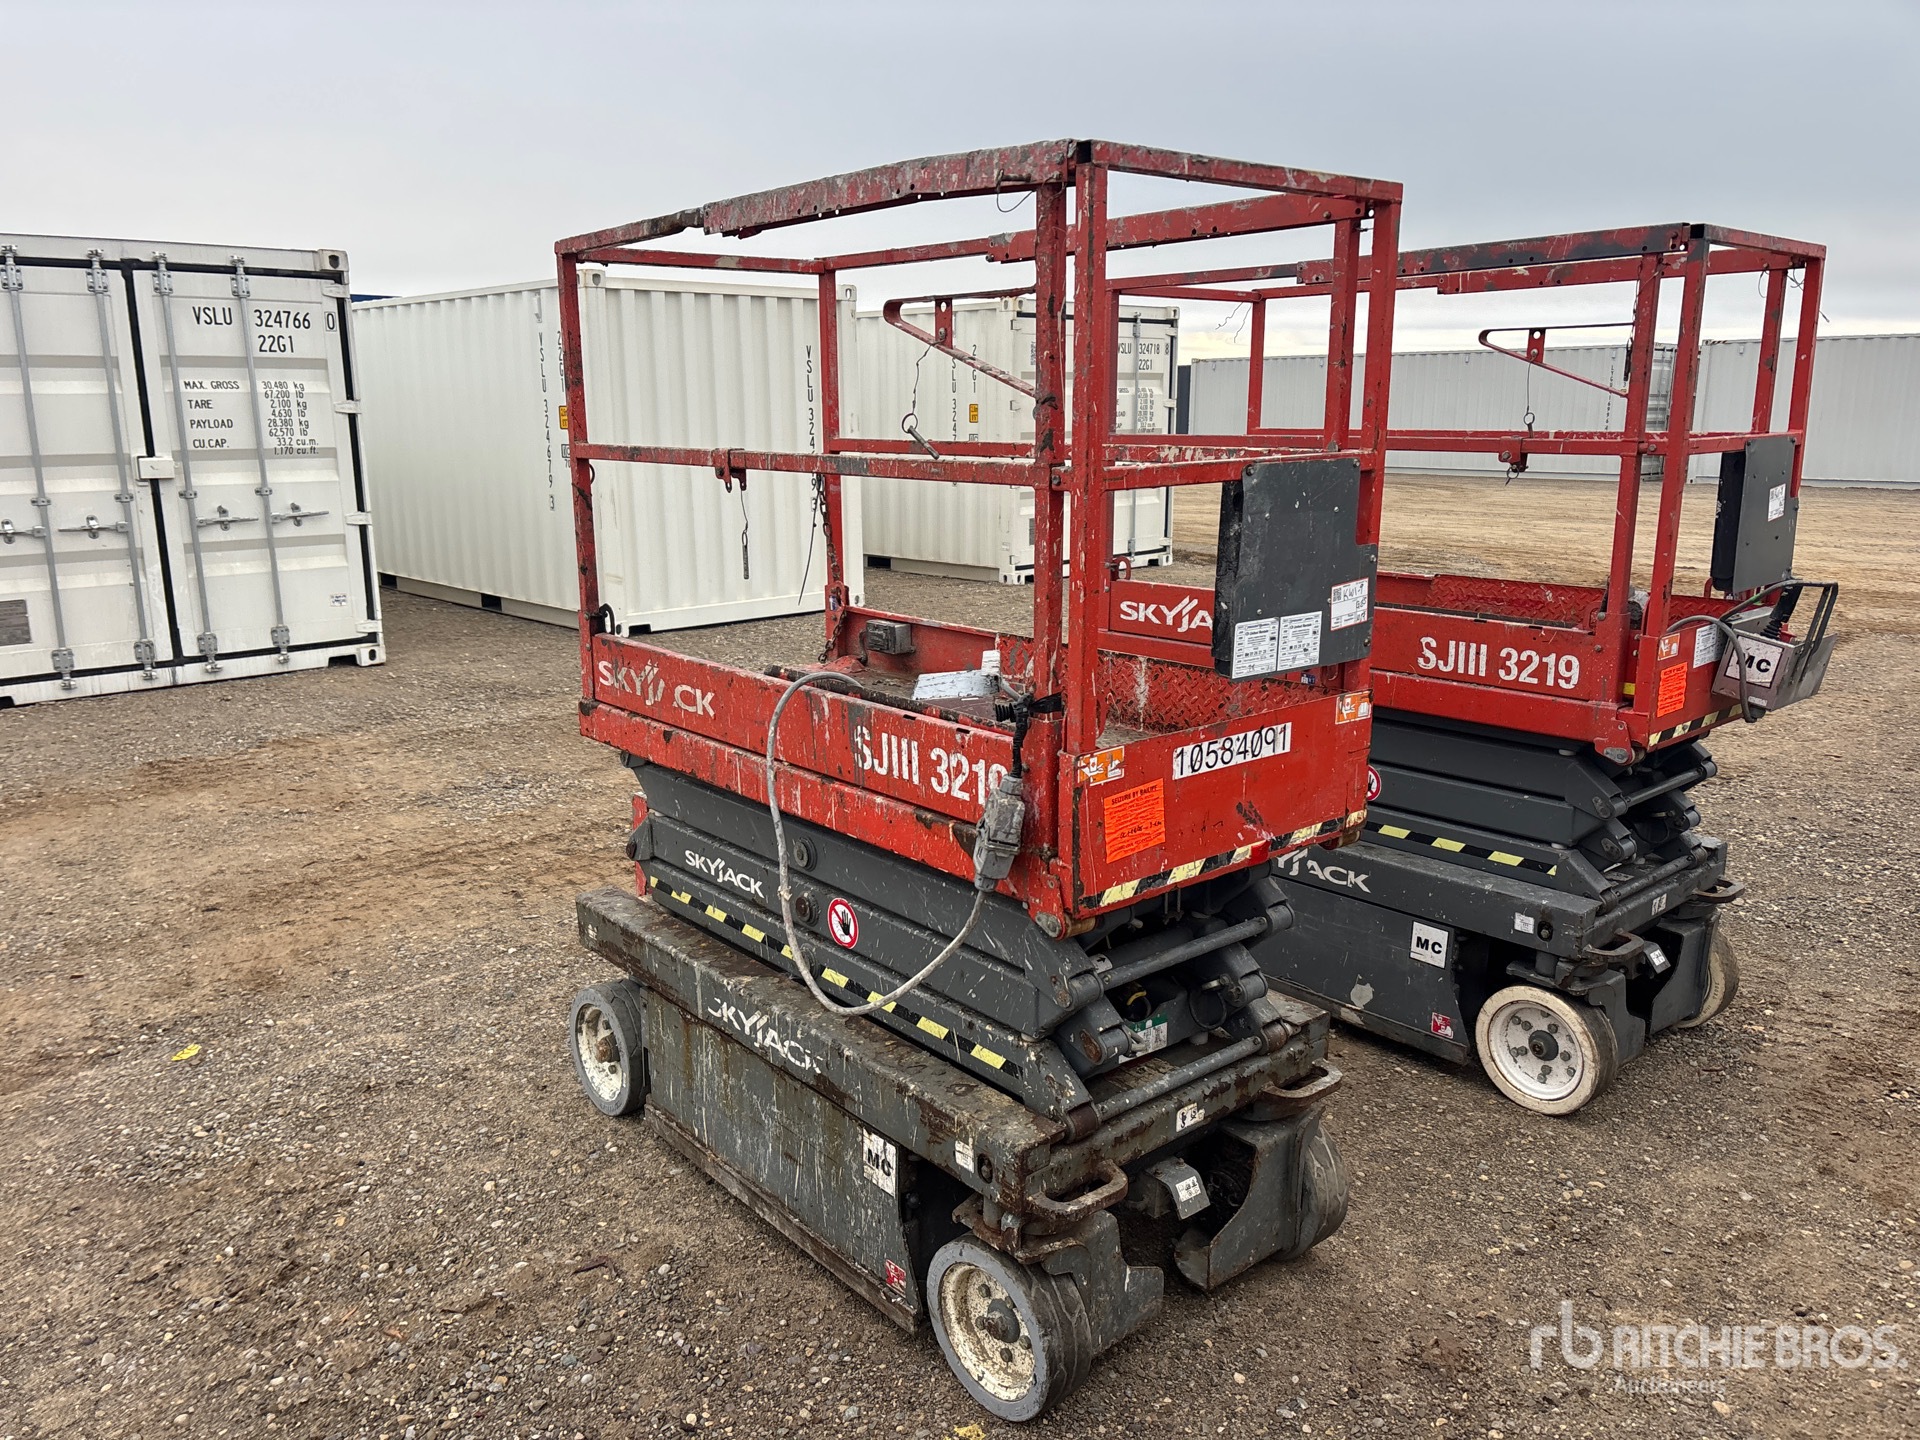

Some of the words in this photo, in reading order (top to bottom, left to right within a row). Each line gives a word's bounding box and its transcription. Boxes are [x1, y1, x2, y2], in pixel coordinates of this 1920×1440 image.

[192, 306, 233, 325] VSLU
[253, 309, 311, 329] 324766
[326, 312, 335, 331] 0
[257, 334, 294, 353] 22G1
[1138, 343, 1160, 355] 324718
[1138, 359, 1152, 370] 22G1
[184, 381, 207, 389] MAX.
[211, 381, 240, 389] GROSS
[261, 381, 288, 389] 30.480
[293, 382, 305, 391] kg
[264, 390, 290, 399] 67.200
[295, 390, 304, 398] lb
[187, 399, 213, 409] TARE
[270, 400, 291, 408] 2.100
[296, 400, 307, 410] kg
[271, 409, 292, 417] 4.630
[297, 409, 306, 417] lb
[539, 331, 547, 393] VSLU
[543, 398, 553, 488] 324679
[190, 419, 233, 429] PAYLOAD
[267, 418, 293, 427] 28.380
[299, 419, 309, 429] kg
[269, 428, 294, 437] 62.570
[193, 438, 229, 448] CU.CAP.
[277, 438, 293, 446] 33.2
[274, 447, 294, 455] 1.170
[296, 446, 319, 455] cu.ft.
[808, 407, 816, 491] 3249
[1120, 595, 1213, 632] SKYJA
[1417, 636, 1487, 677] SJIII
[1498, 647, 1580, 689] 3219
[853, 725, 919, 785] SJIII
[1176, 724, 1287, 776] 10584091
[685, 850, 765, 899] SKYJACK
[1276, 848, 1371, 894] YJACK
[1416, 936, 1443, 955] MC
[867, 1148, 894, 1177] MC
